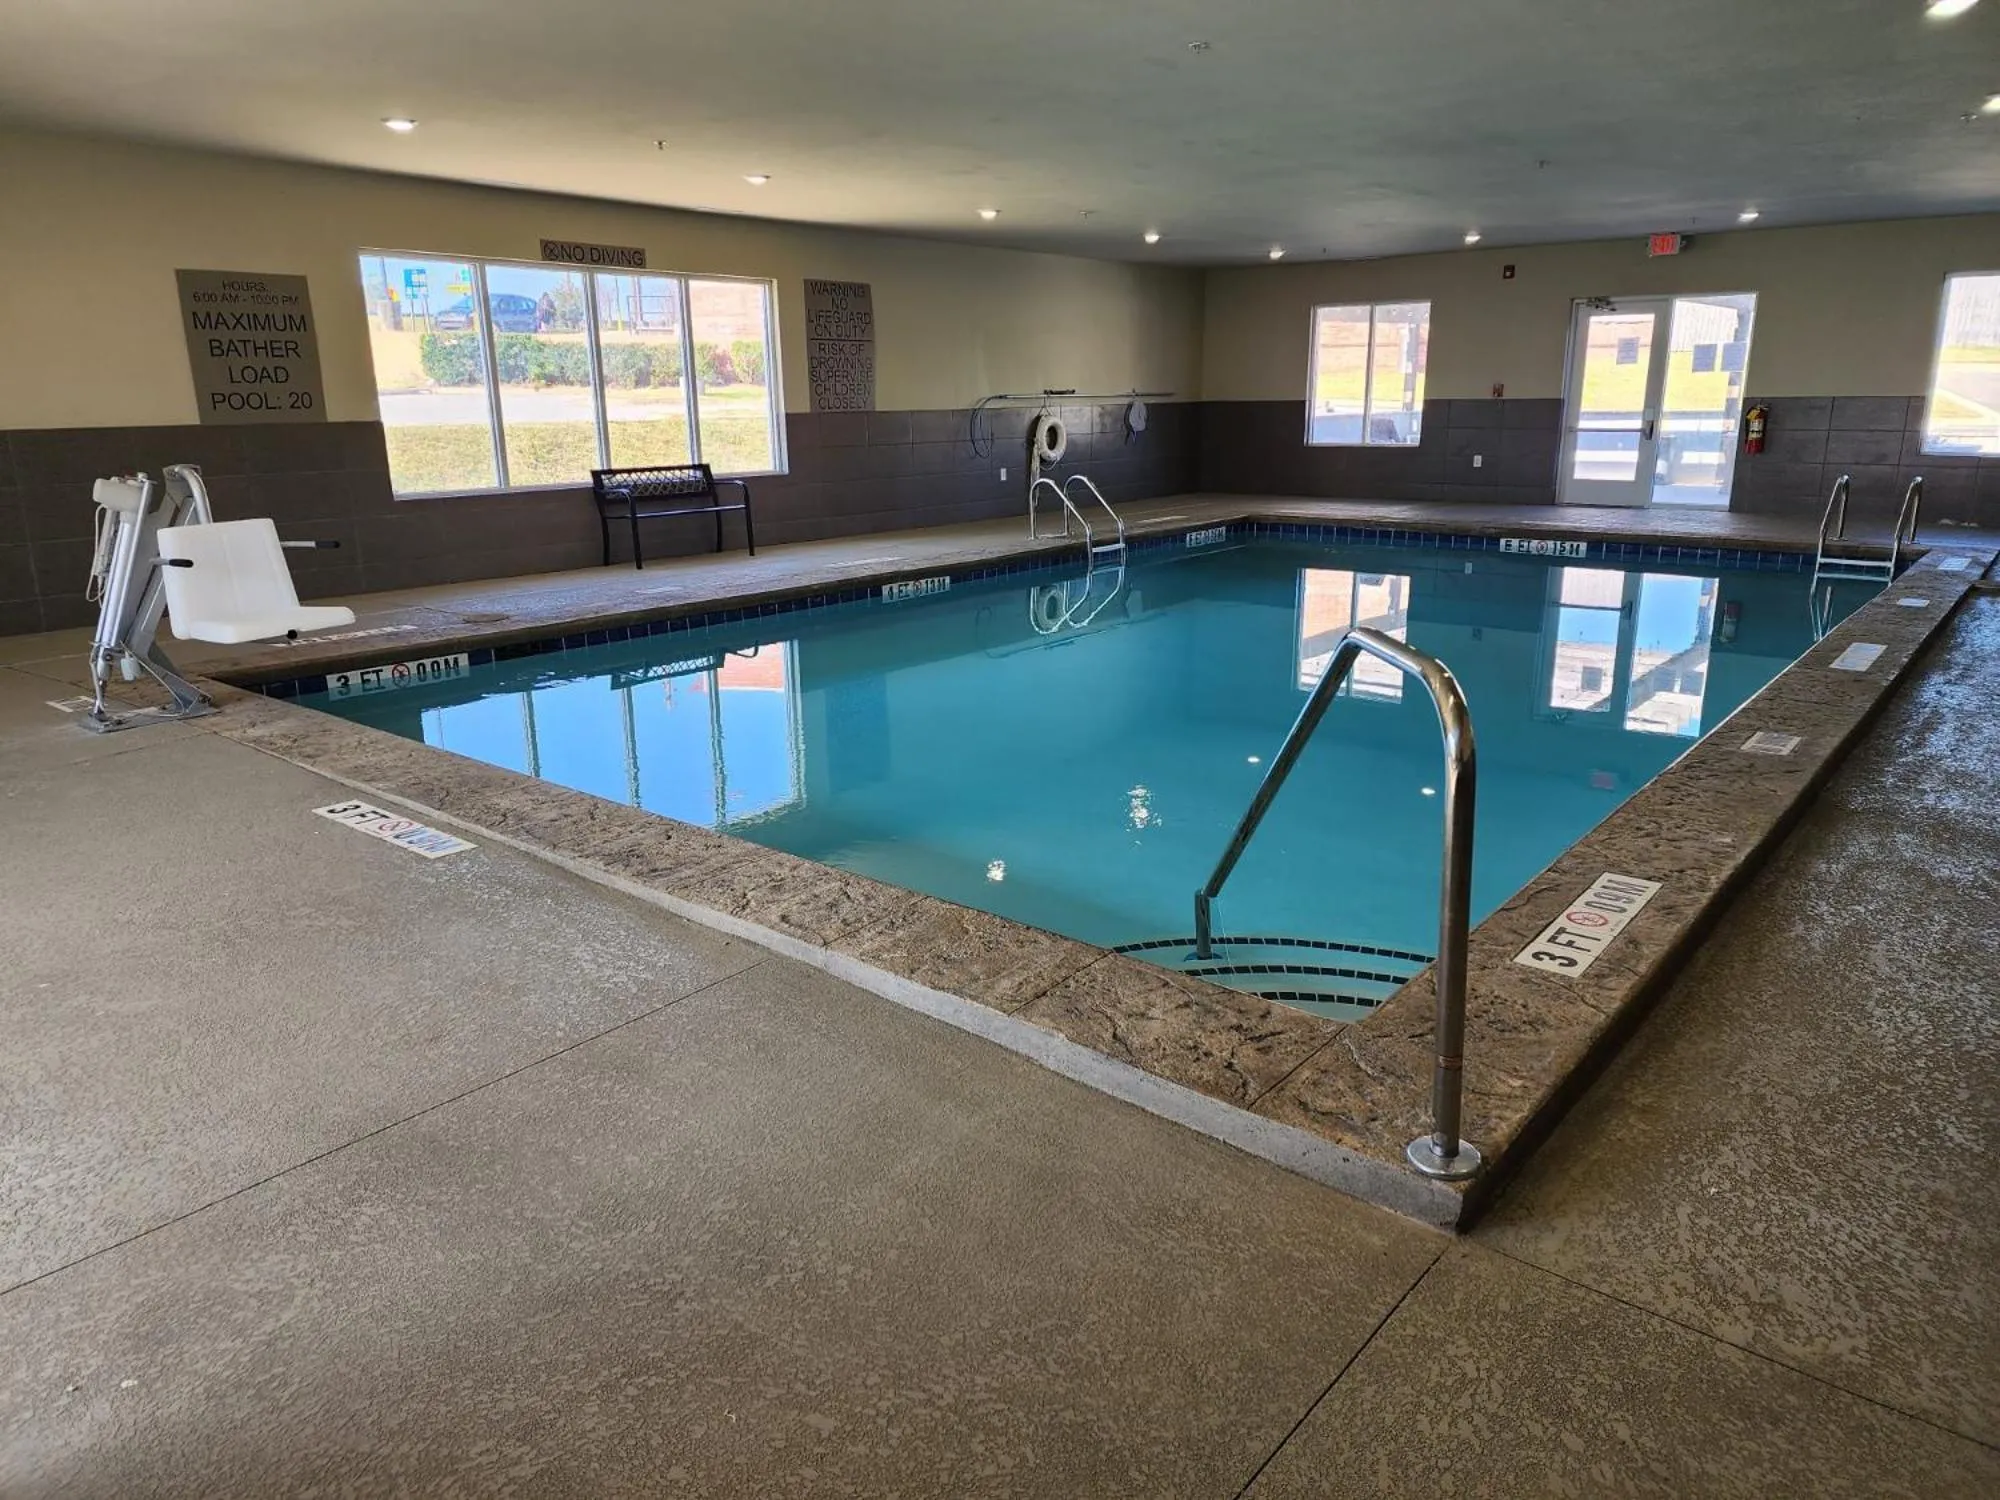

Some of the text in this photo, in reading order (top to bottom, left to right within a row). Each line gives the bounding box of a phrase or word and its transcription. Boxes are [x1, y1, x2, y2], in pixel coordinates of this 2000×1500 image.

[560, 244, 644, 267] NO DIVING
[810, 281, 866, 298] WARNING
[221, 292, 240, 304] AM
[282, 295, 299, 306] PM
[831, 297, 849, 310] NO
[192, 311, 308, 332] MAXIMUM
[807, 309, 872, 325] LIFEGUARD
[815, 323, 867, 339] ON DUTY
[208, 338, 302, 358] BATHER
[818, 342, 865, 356] RISK OF
[810, 356, 873, 370] DROWNING
[228, 366, 290, 384] LOAD
[810, 369, 873, 383] SUPERVISE
[815, 383, 871, 397] CHILDREN
[210, 391, 313, 411] POOL: 20
[818, 397, 869, 410] CLOSELY
[327, 804, 361, 814] 3
[346, 810, 390, 825] FT
[1546, 926, 1602, 953] FT
[1531, 950, 1578, 968] 3
